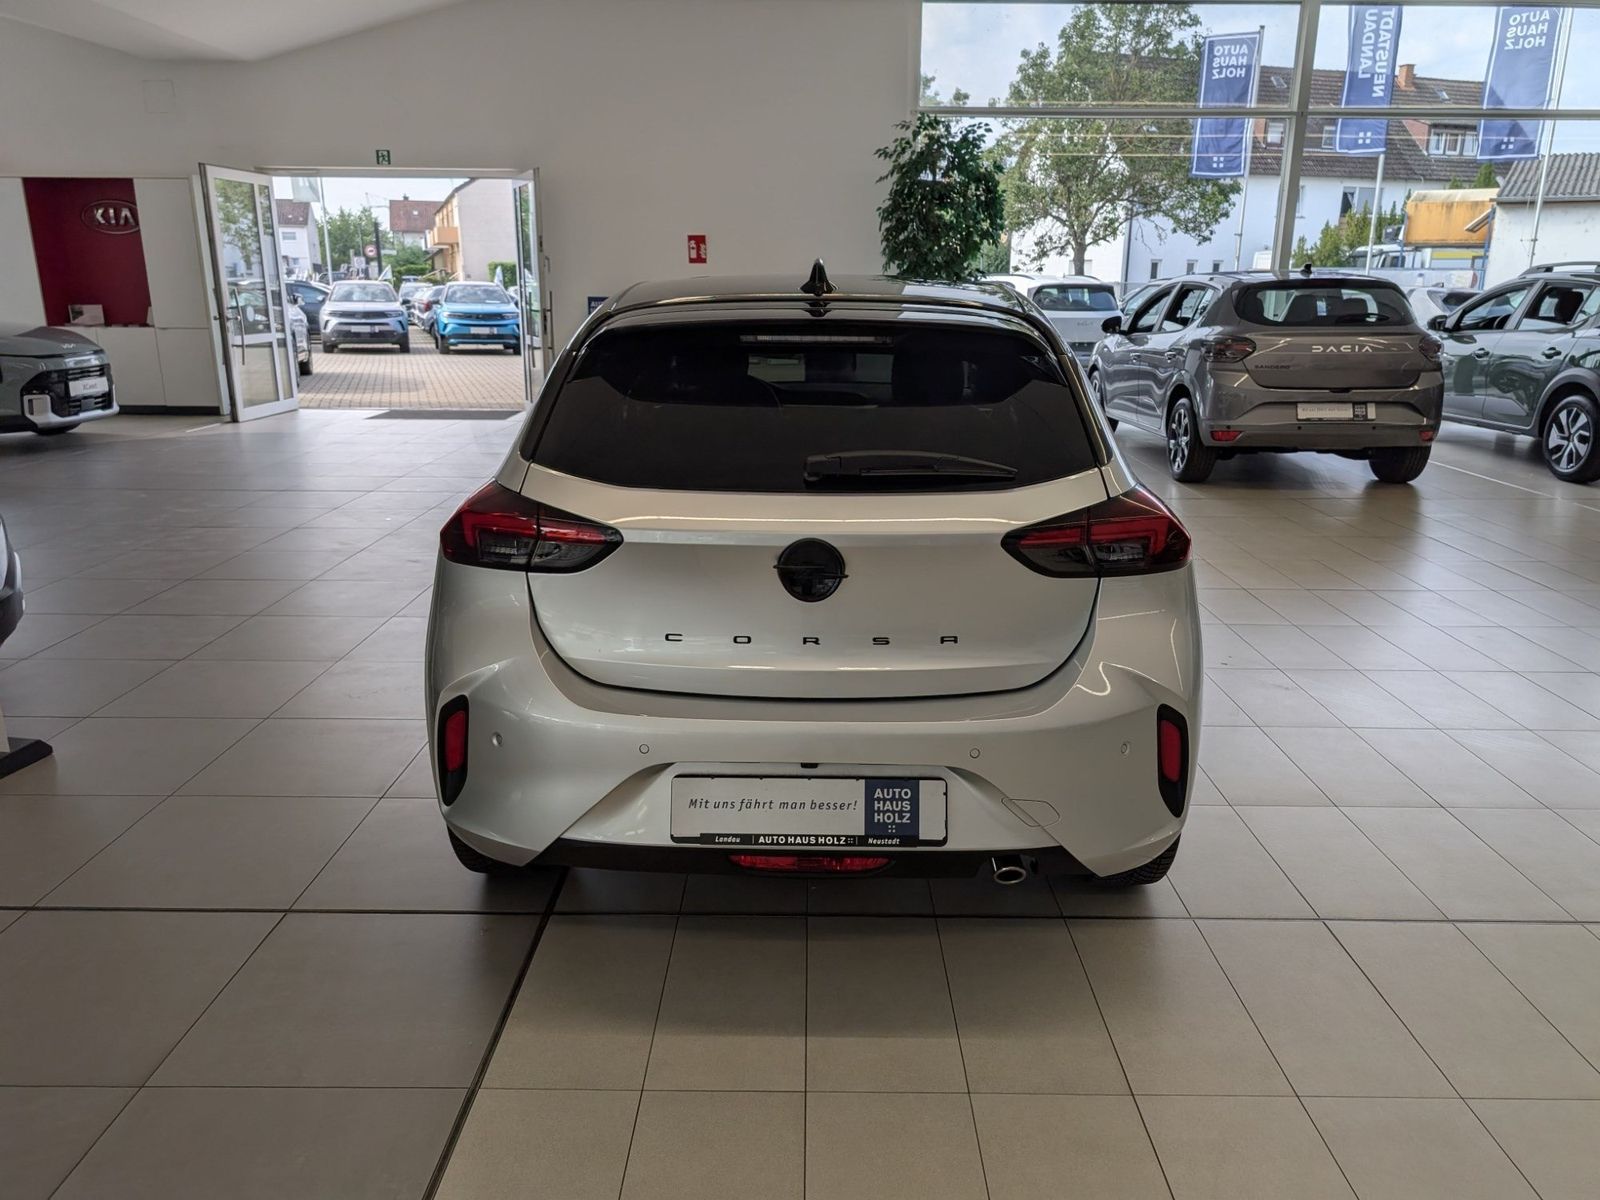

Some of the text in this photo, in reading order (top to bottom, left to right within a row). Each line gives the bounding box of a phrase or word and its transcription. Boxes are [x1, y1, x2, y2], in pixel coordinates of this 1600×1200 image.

[94, 207, 136, 226] KIA
[1311, 345, 1373, 353] DACIA
[664, 632, 959, 646] CORSA
[873, 788, 912, 799] AUTO
[688, 798, 858, 812] Mit uns fährt man besser!
[873, 800, 911, 811] HAUS
[873, 812, 911, 823] HOLZ
[715, 835, 900, 845] Landau AUTO HAUS HOLZ Neustadt
